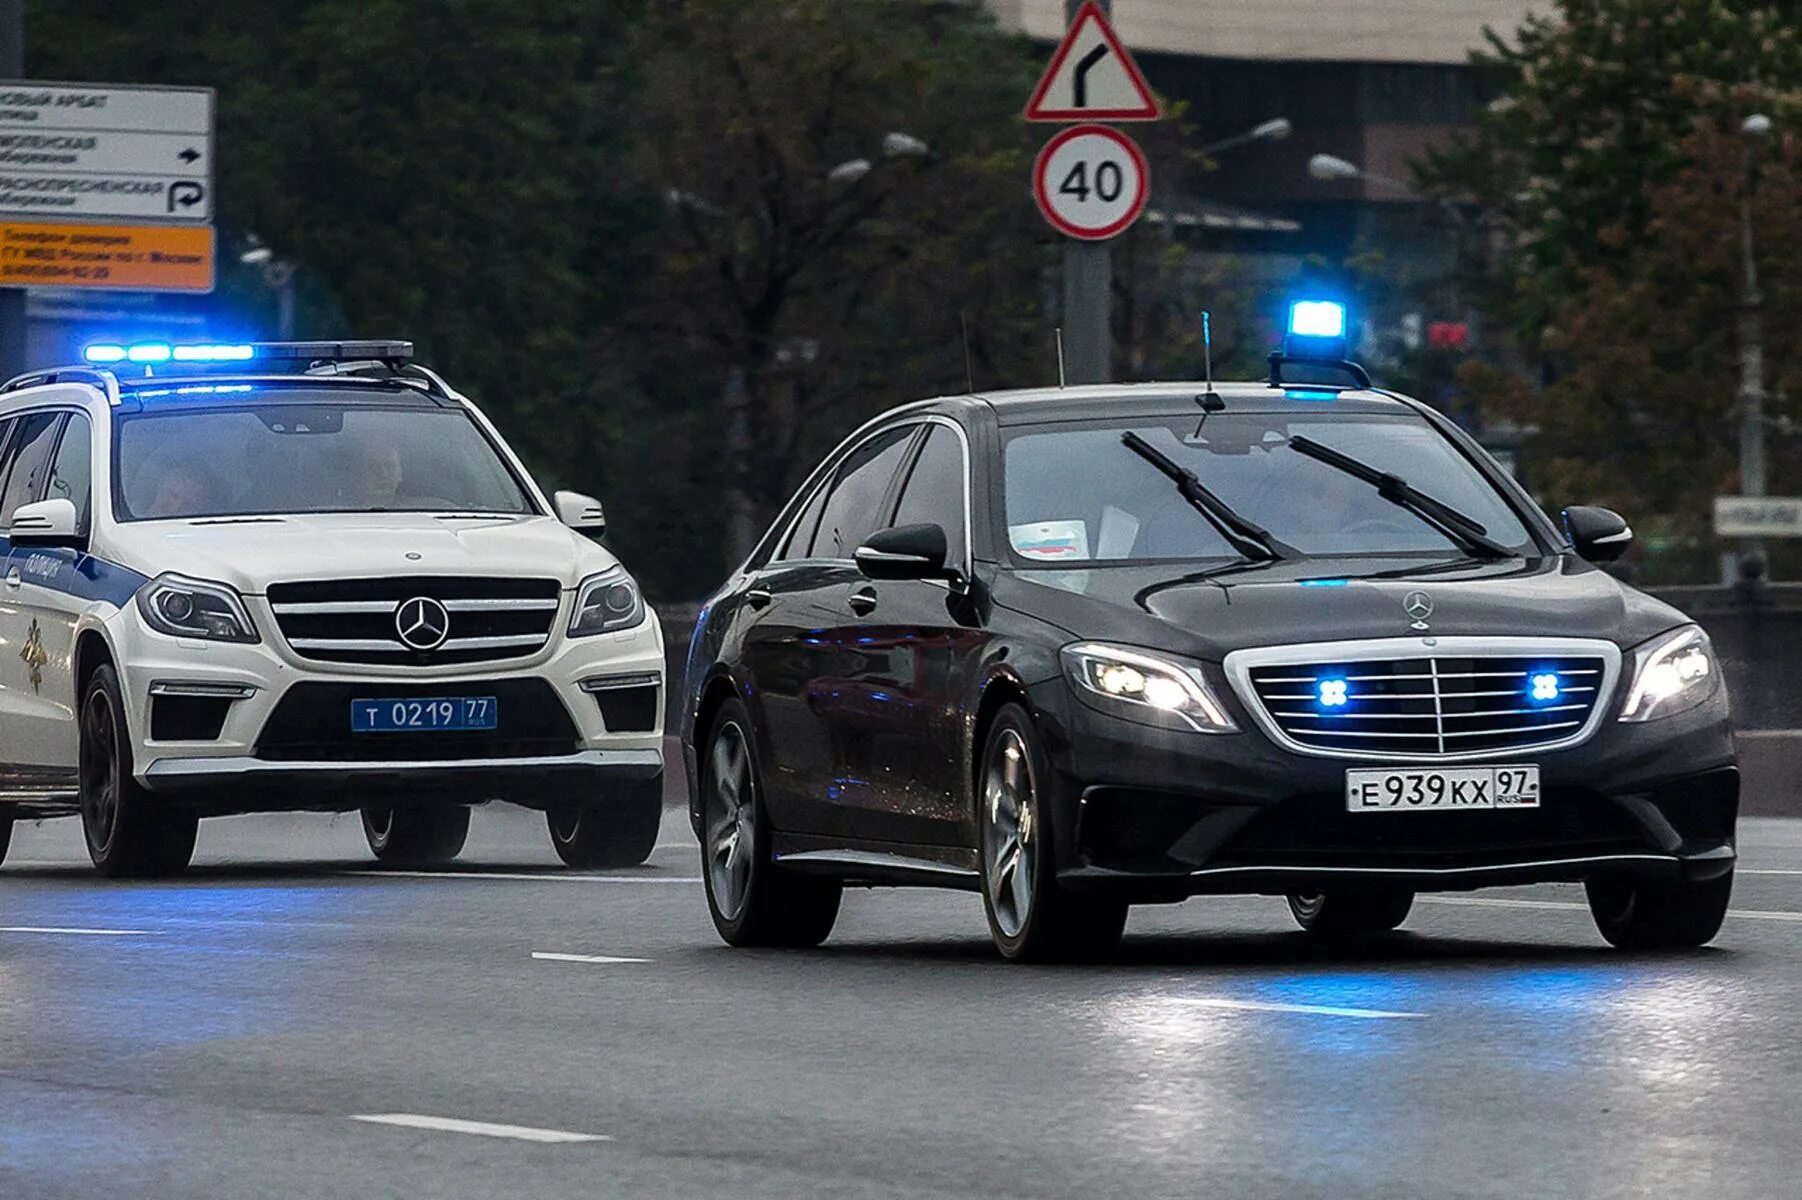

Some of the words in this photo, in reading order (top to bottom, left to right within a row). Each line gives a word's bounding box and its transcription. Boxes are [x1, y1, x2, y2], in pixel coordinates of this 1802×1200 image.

[1060, 161, 1123, 203] 40
[366, 708, 379, 726] Т
[392, 702, 454, 726] 0219
[466, 700, 488, 718] 77
[1498, 771, 1527, 794] 97
[1497, 794, 1520, 803] RUS
